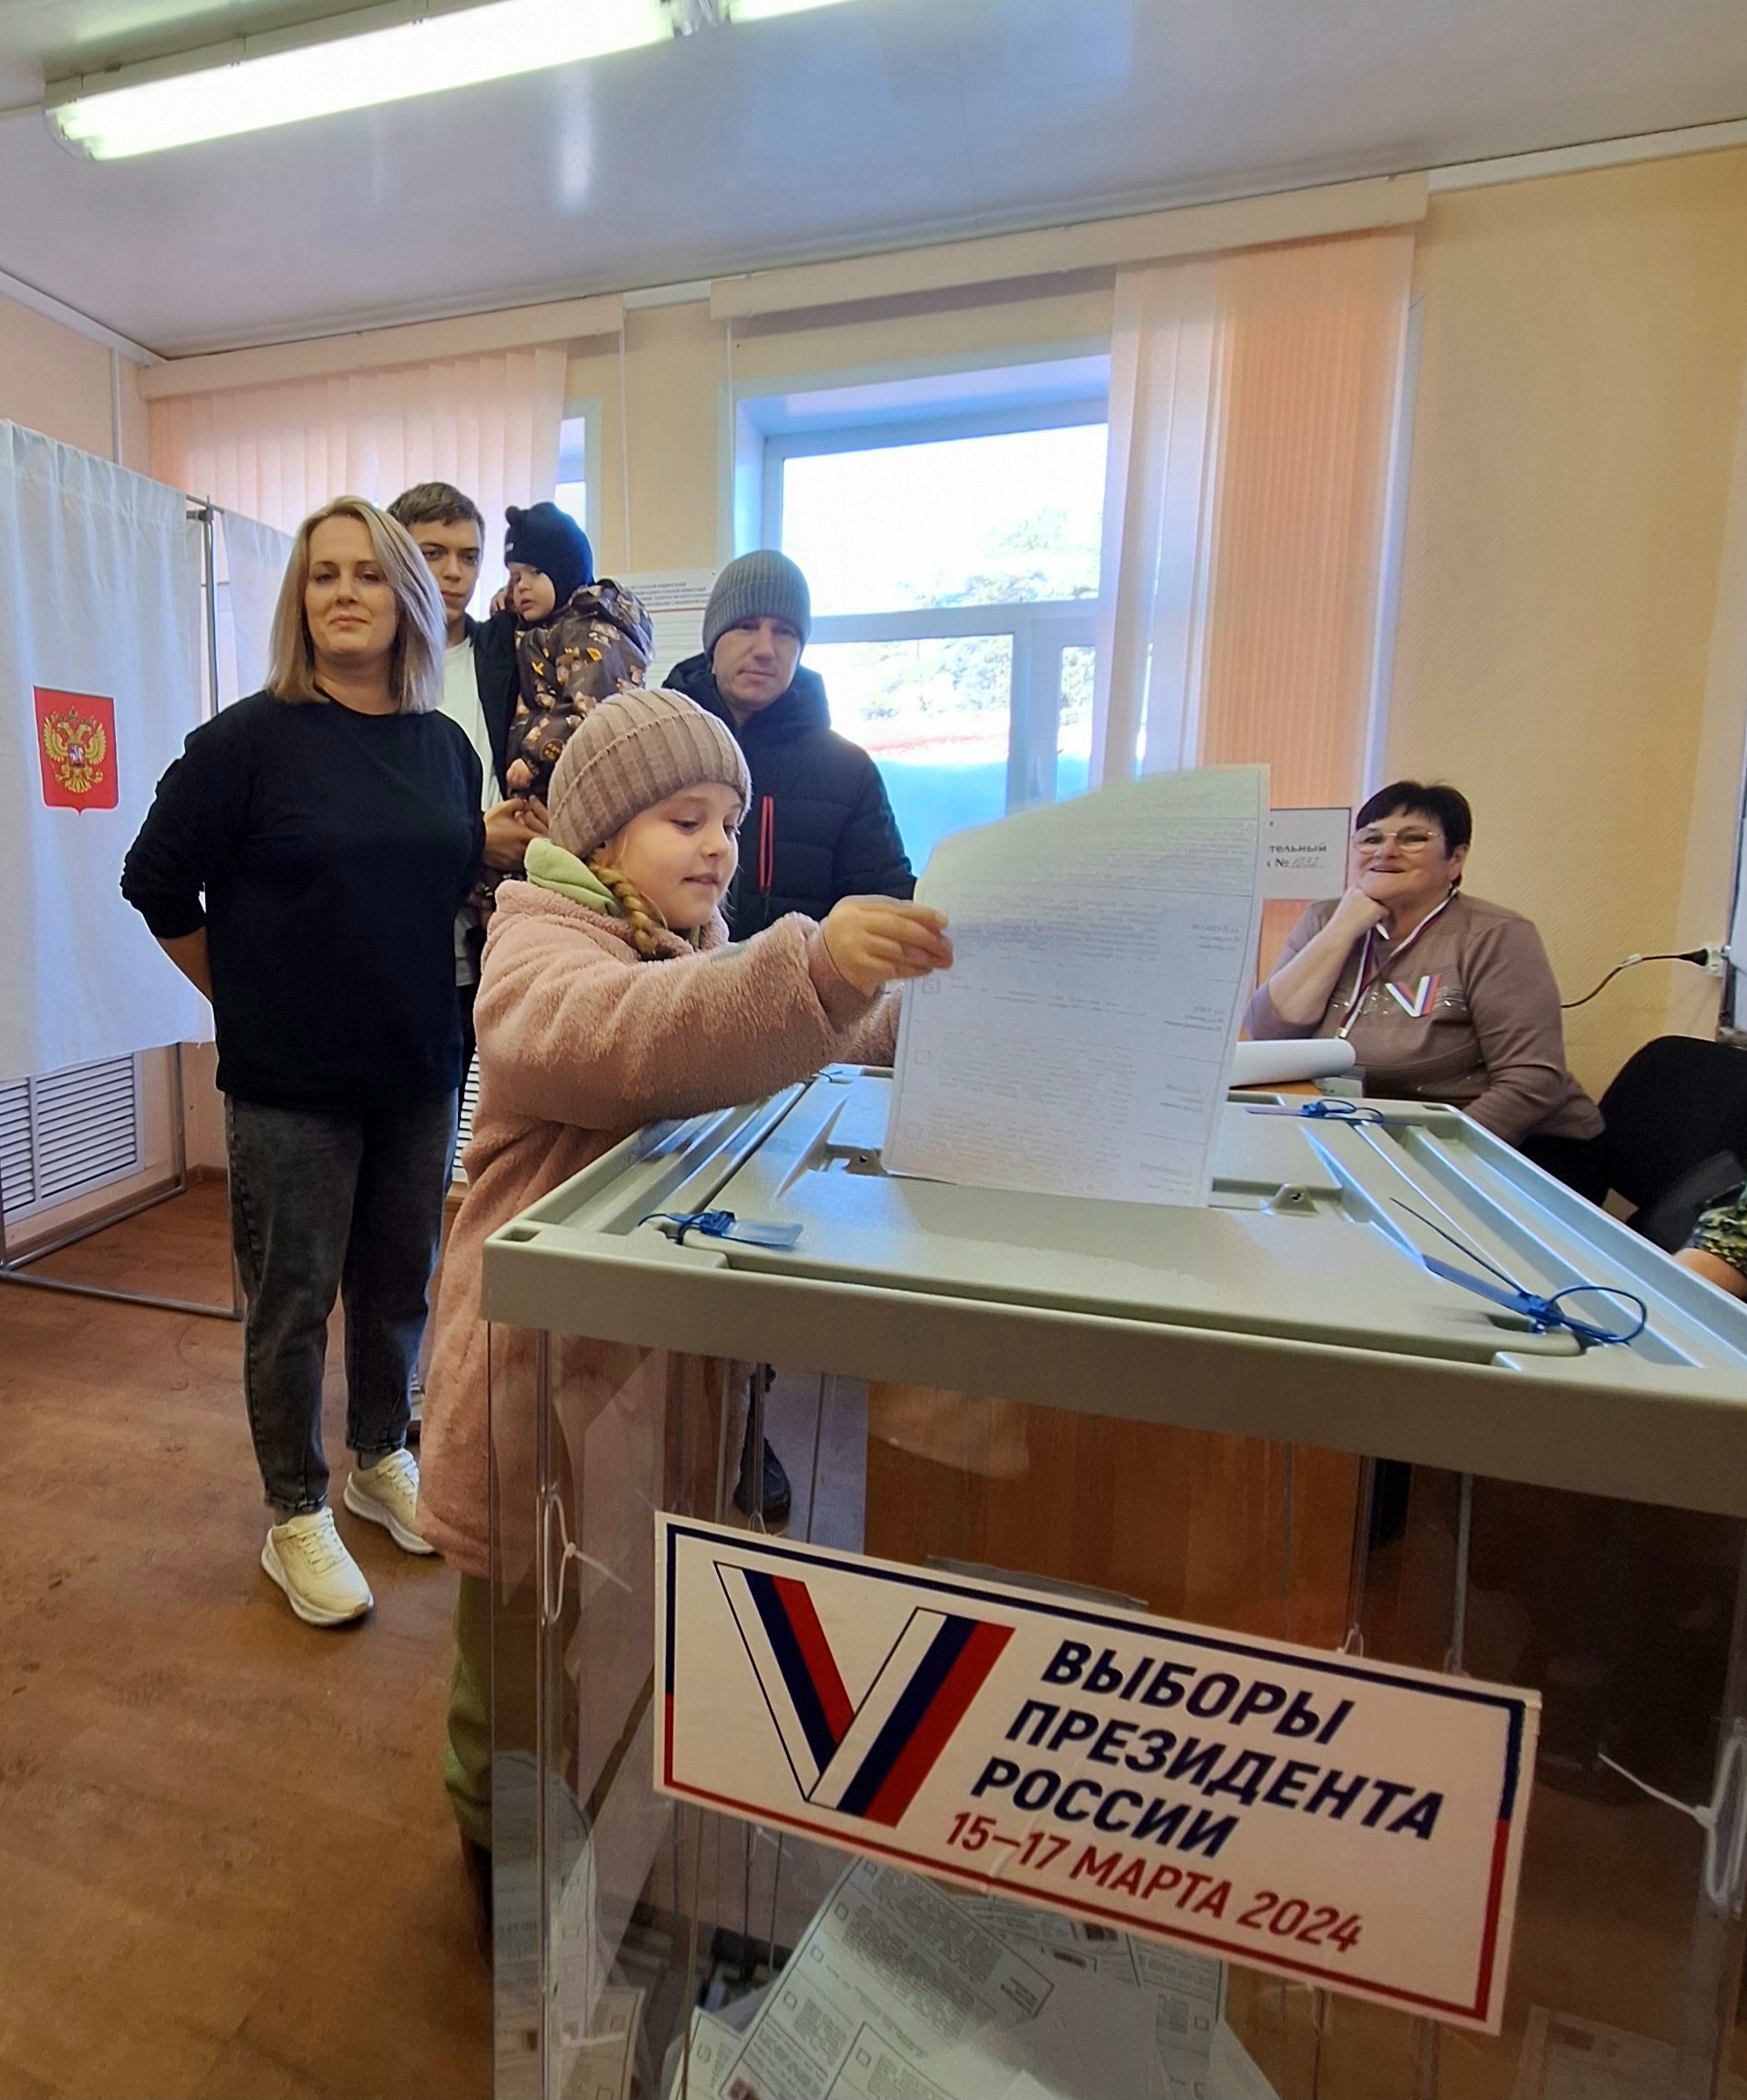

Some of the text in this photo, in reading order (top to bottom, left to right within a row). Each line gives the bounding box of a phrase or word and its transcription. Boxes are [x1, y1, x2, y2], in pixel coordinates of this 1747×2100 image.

[1041, 1639, 1355, 1746] ВЫБОРЫ
[970, 1756, 1240, 1859] РОССИИ
[1005, 1698, 1445, 1841] ПРЕЗИДЕНТА
[1069, 1845, 1233, 1920] МАРТА
[1236, 1890, 1363, 1954] 2024
